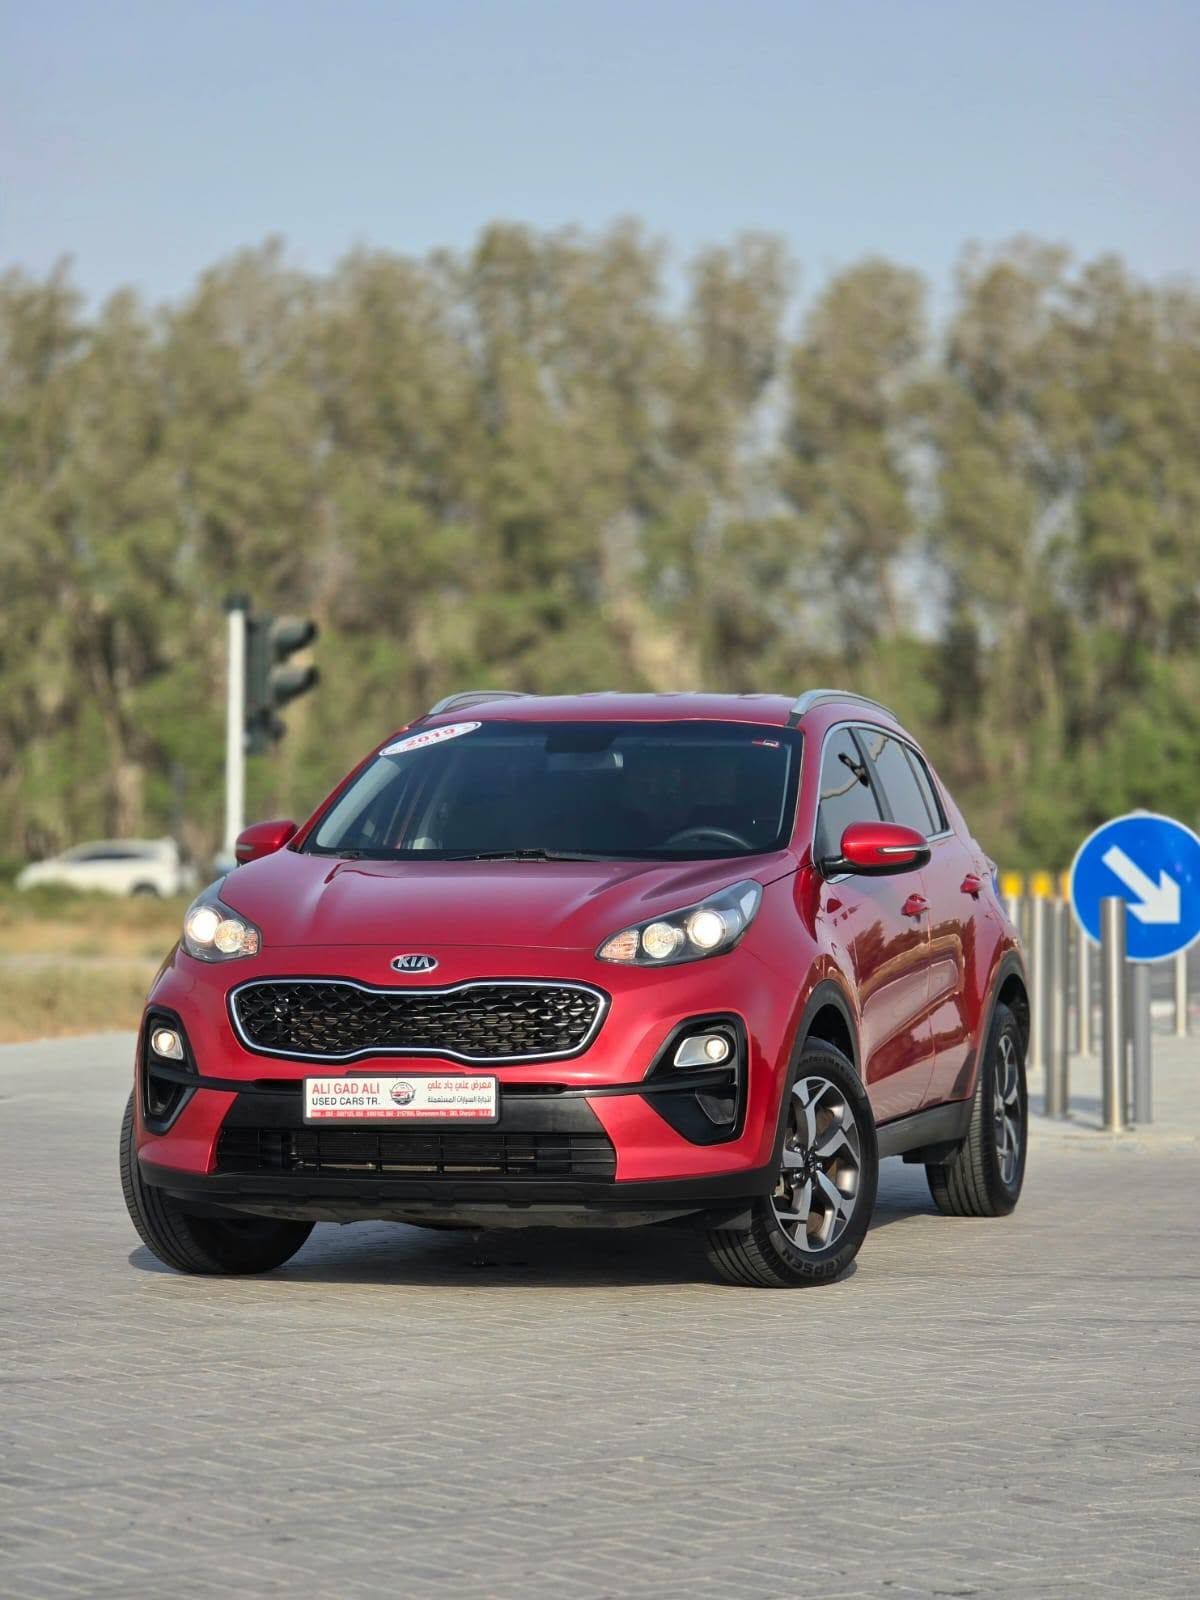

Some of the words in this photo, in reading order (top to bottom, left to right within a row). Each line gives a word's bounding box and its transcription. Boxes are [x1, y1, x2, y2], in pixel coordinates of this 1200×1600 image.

[397, 956, 430, 968] KIA
[312, 1082, 331, 1095] ALI
[333, 1082, 359, 1095] GAD
[361, 1082, 380, 1095] ALI
[427, 1080, 442, 1092] علي
[454, 1080, 469, 1092] علي
[470, 1080, 492, 1091] معرض
[312, 1097, 337, 1106] USED
[339, 1097, 365, 1106] CARS
[366, 1097, 381, 1106] TR.
